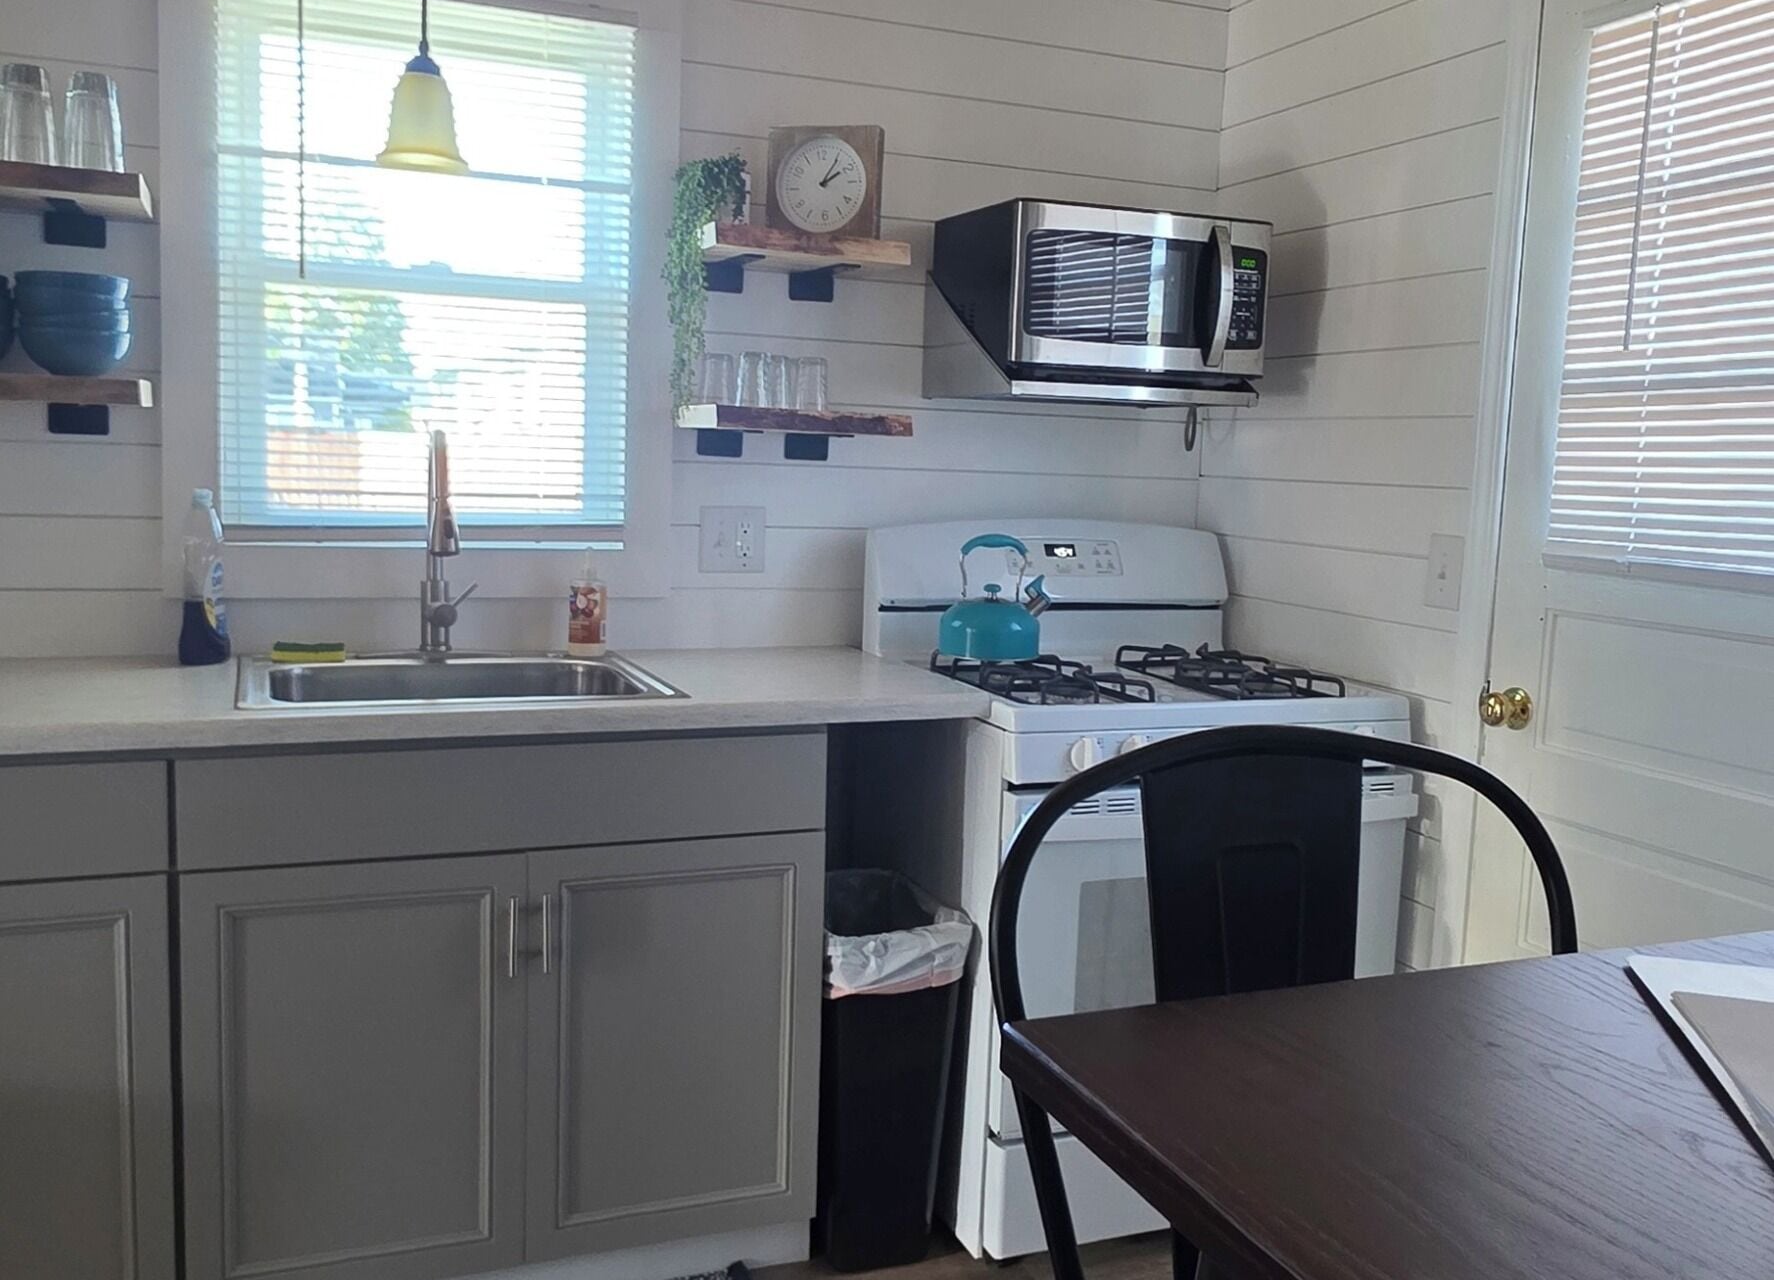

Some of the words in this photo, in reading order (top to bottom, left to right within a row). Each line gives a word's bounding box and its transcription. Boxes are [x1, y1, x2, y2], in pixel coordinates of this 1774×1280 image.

[817, 150, 828, 161] 12
[793, 166, 805, 179] 10
[842, 163, 855, 175] 2
[843, 195, 853, 205] 4
[821, 210, 830, 221] 6
